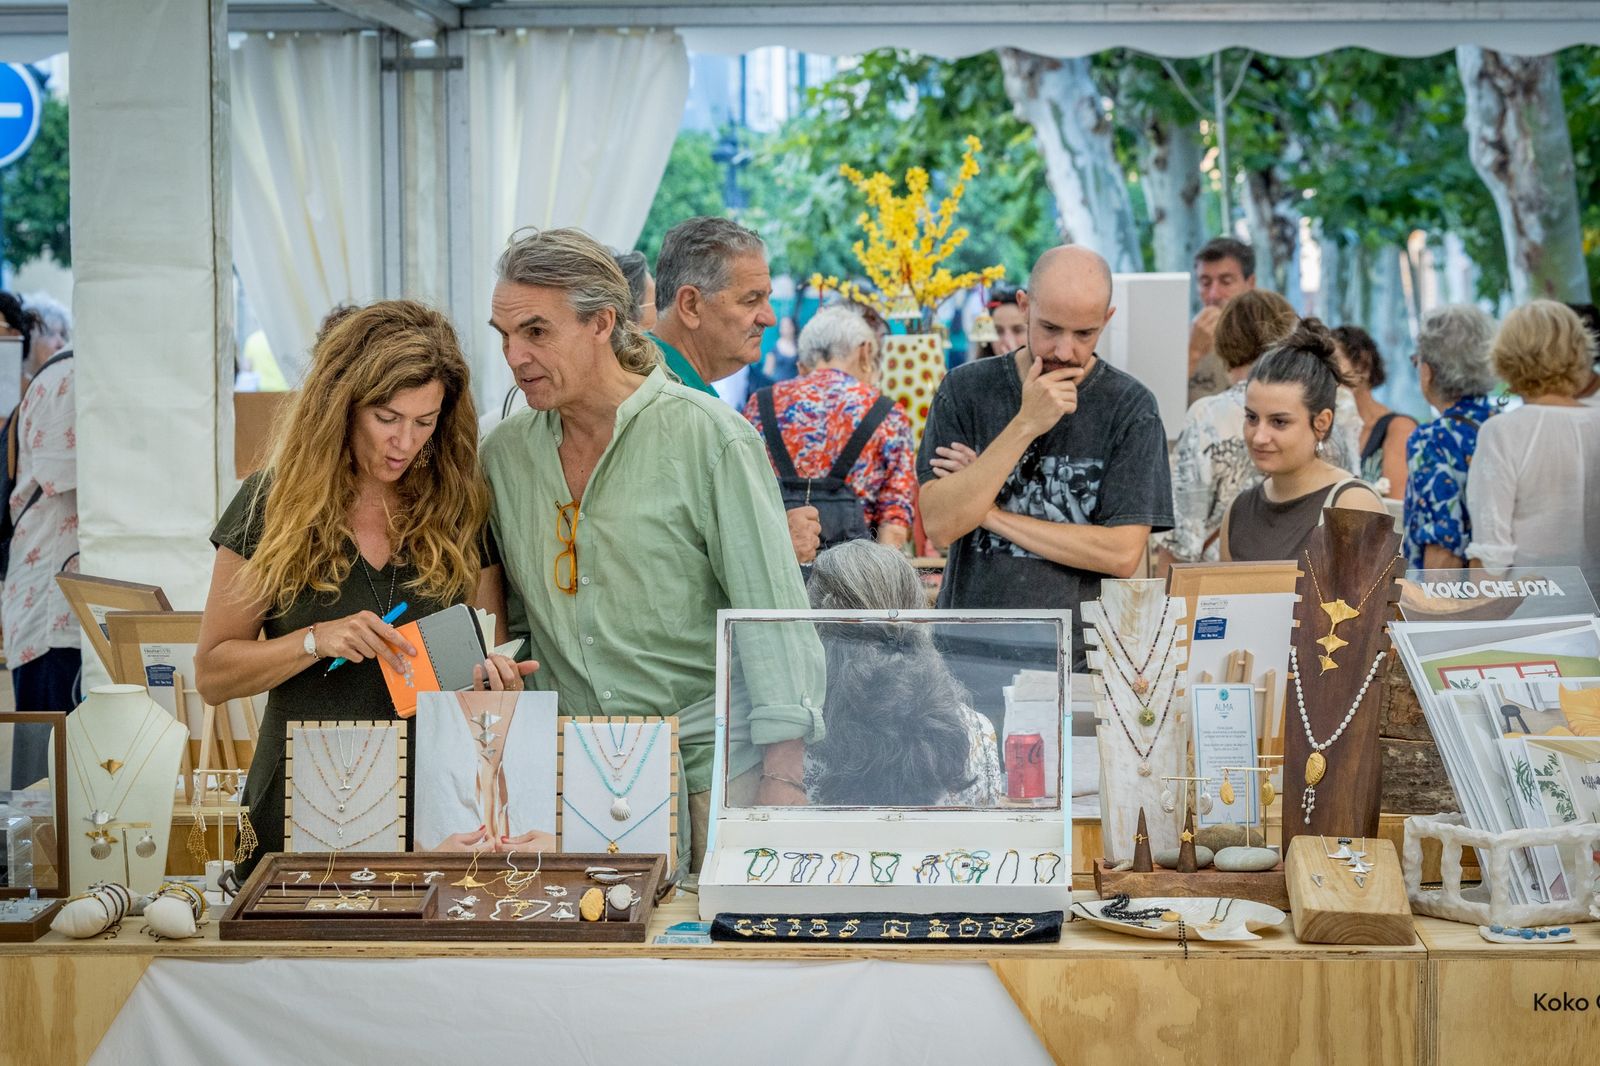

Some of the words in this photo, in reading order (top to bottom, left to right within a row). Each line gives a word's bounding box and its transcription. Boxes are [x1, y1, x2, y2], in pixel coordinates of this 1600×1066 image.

[1420, 582, 1480, 599] KOKO
[1214, 703, 1233, 711] ALMA
[1533, 991, 1589, 1011] Koko
